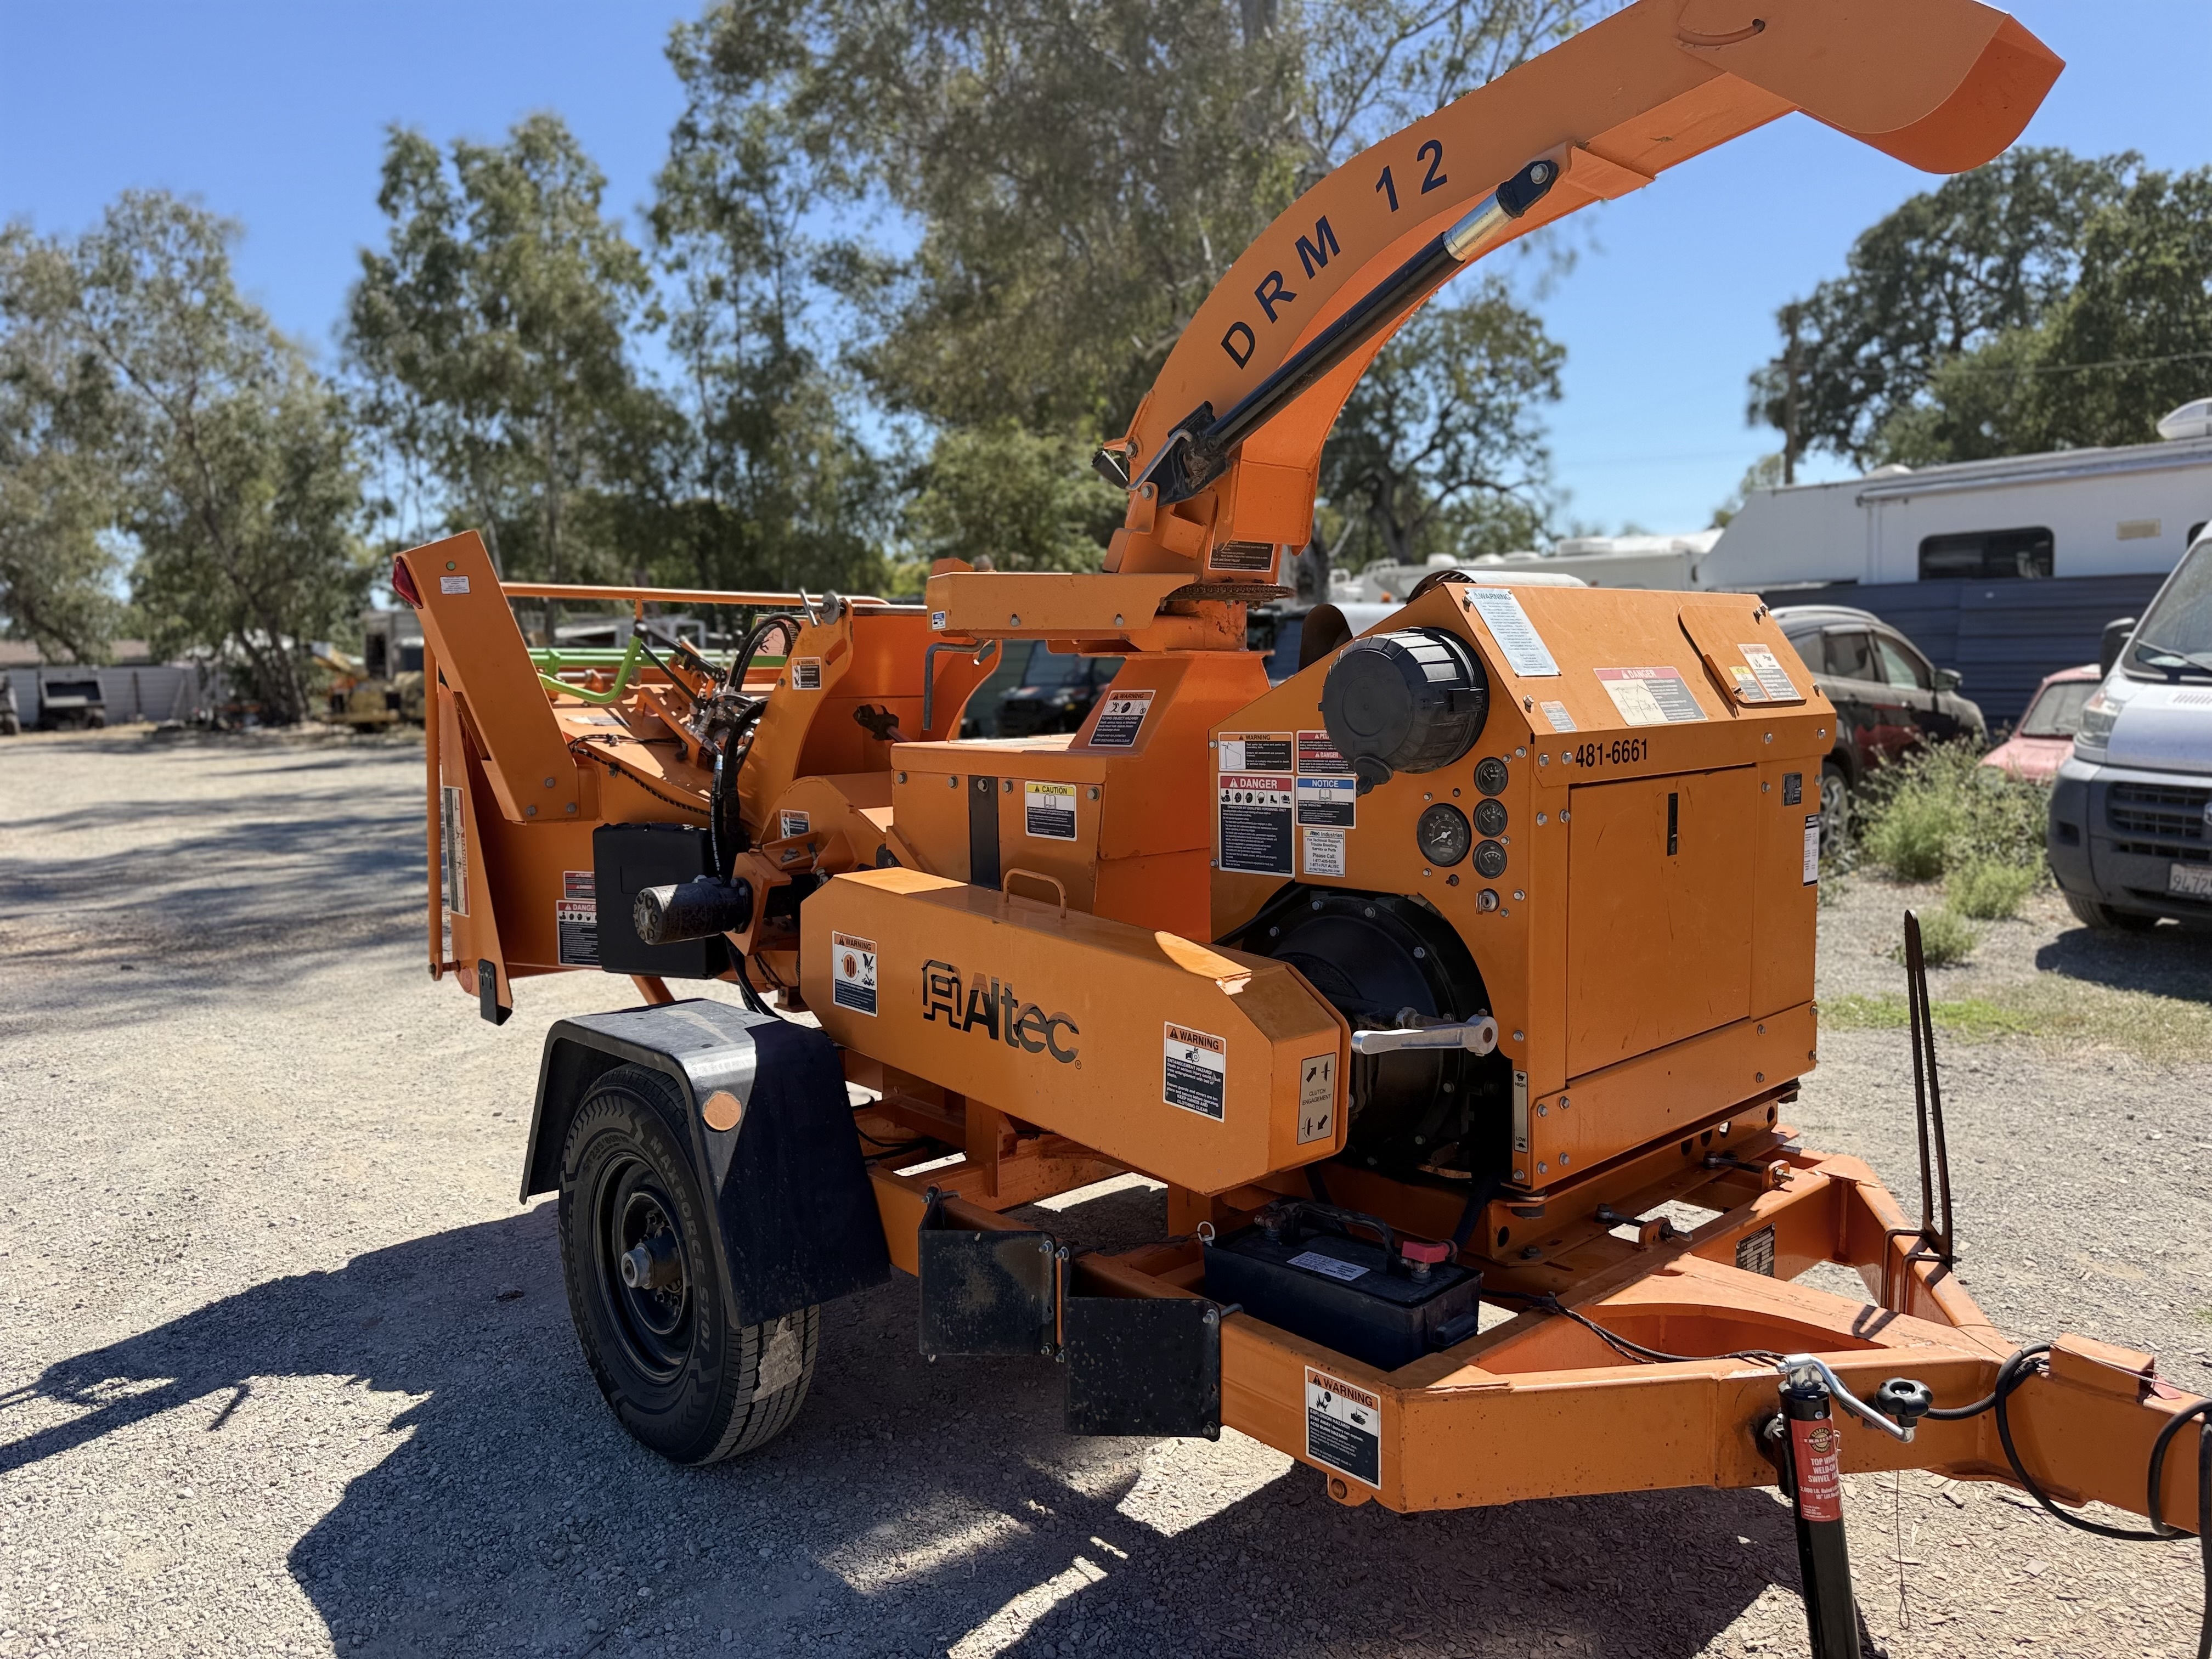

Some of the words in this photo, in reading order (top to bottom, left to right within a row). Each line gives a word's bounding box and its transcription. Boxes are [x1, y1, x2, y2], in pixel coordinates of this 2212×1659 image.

[1220, 215, 1341, 370] DRM
[1376, 139, 1448, 213] 12
[1628, 669, 1657, 678] DANGER
[1575, 738, 1647, 768] 481-6661
[1240, 778, 1277, 789] DANGER
[1042, 786, 1067, 794] CAUTION
[845, 938, 871, 951] WARNING
[962, 972, 1080, 1063] Altec
[1180, 1030, 1219, 1050] WARNING
[1167, 1058, 1195, 1070] ENTANGLEMENT
[1196, 1067, 1212, 1075] HAZARD!
[1175, 1070, 1196, 1080] entanglement
[1309, 1088, 1325, 1096] CLUTCH
[1177, 1099, 1195, 1109] CLOTHING
[1302, 1093, 1331, 1105] ENGAGEMENT
[650, 1135, 706, 1274] MAXFORCE
[1323, 1378, 1373, 1407] WARNING
[1310, 1408, 1332, 1421] EXPLOSION
[1332, 1419, 1350, 1430] HAZARD!
[1320, 1424, 1330, 1433] BURN
[1331, 1430, 1348, 1441] HAZARD!
[1333, 1425, 1344, 1434] Battery
[1810, 1458, 1823, 1466] TOP
[1808, 1475, 1830, 1483] SWIVEL
